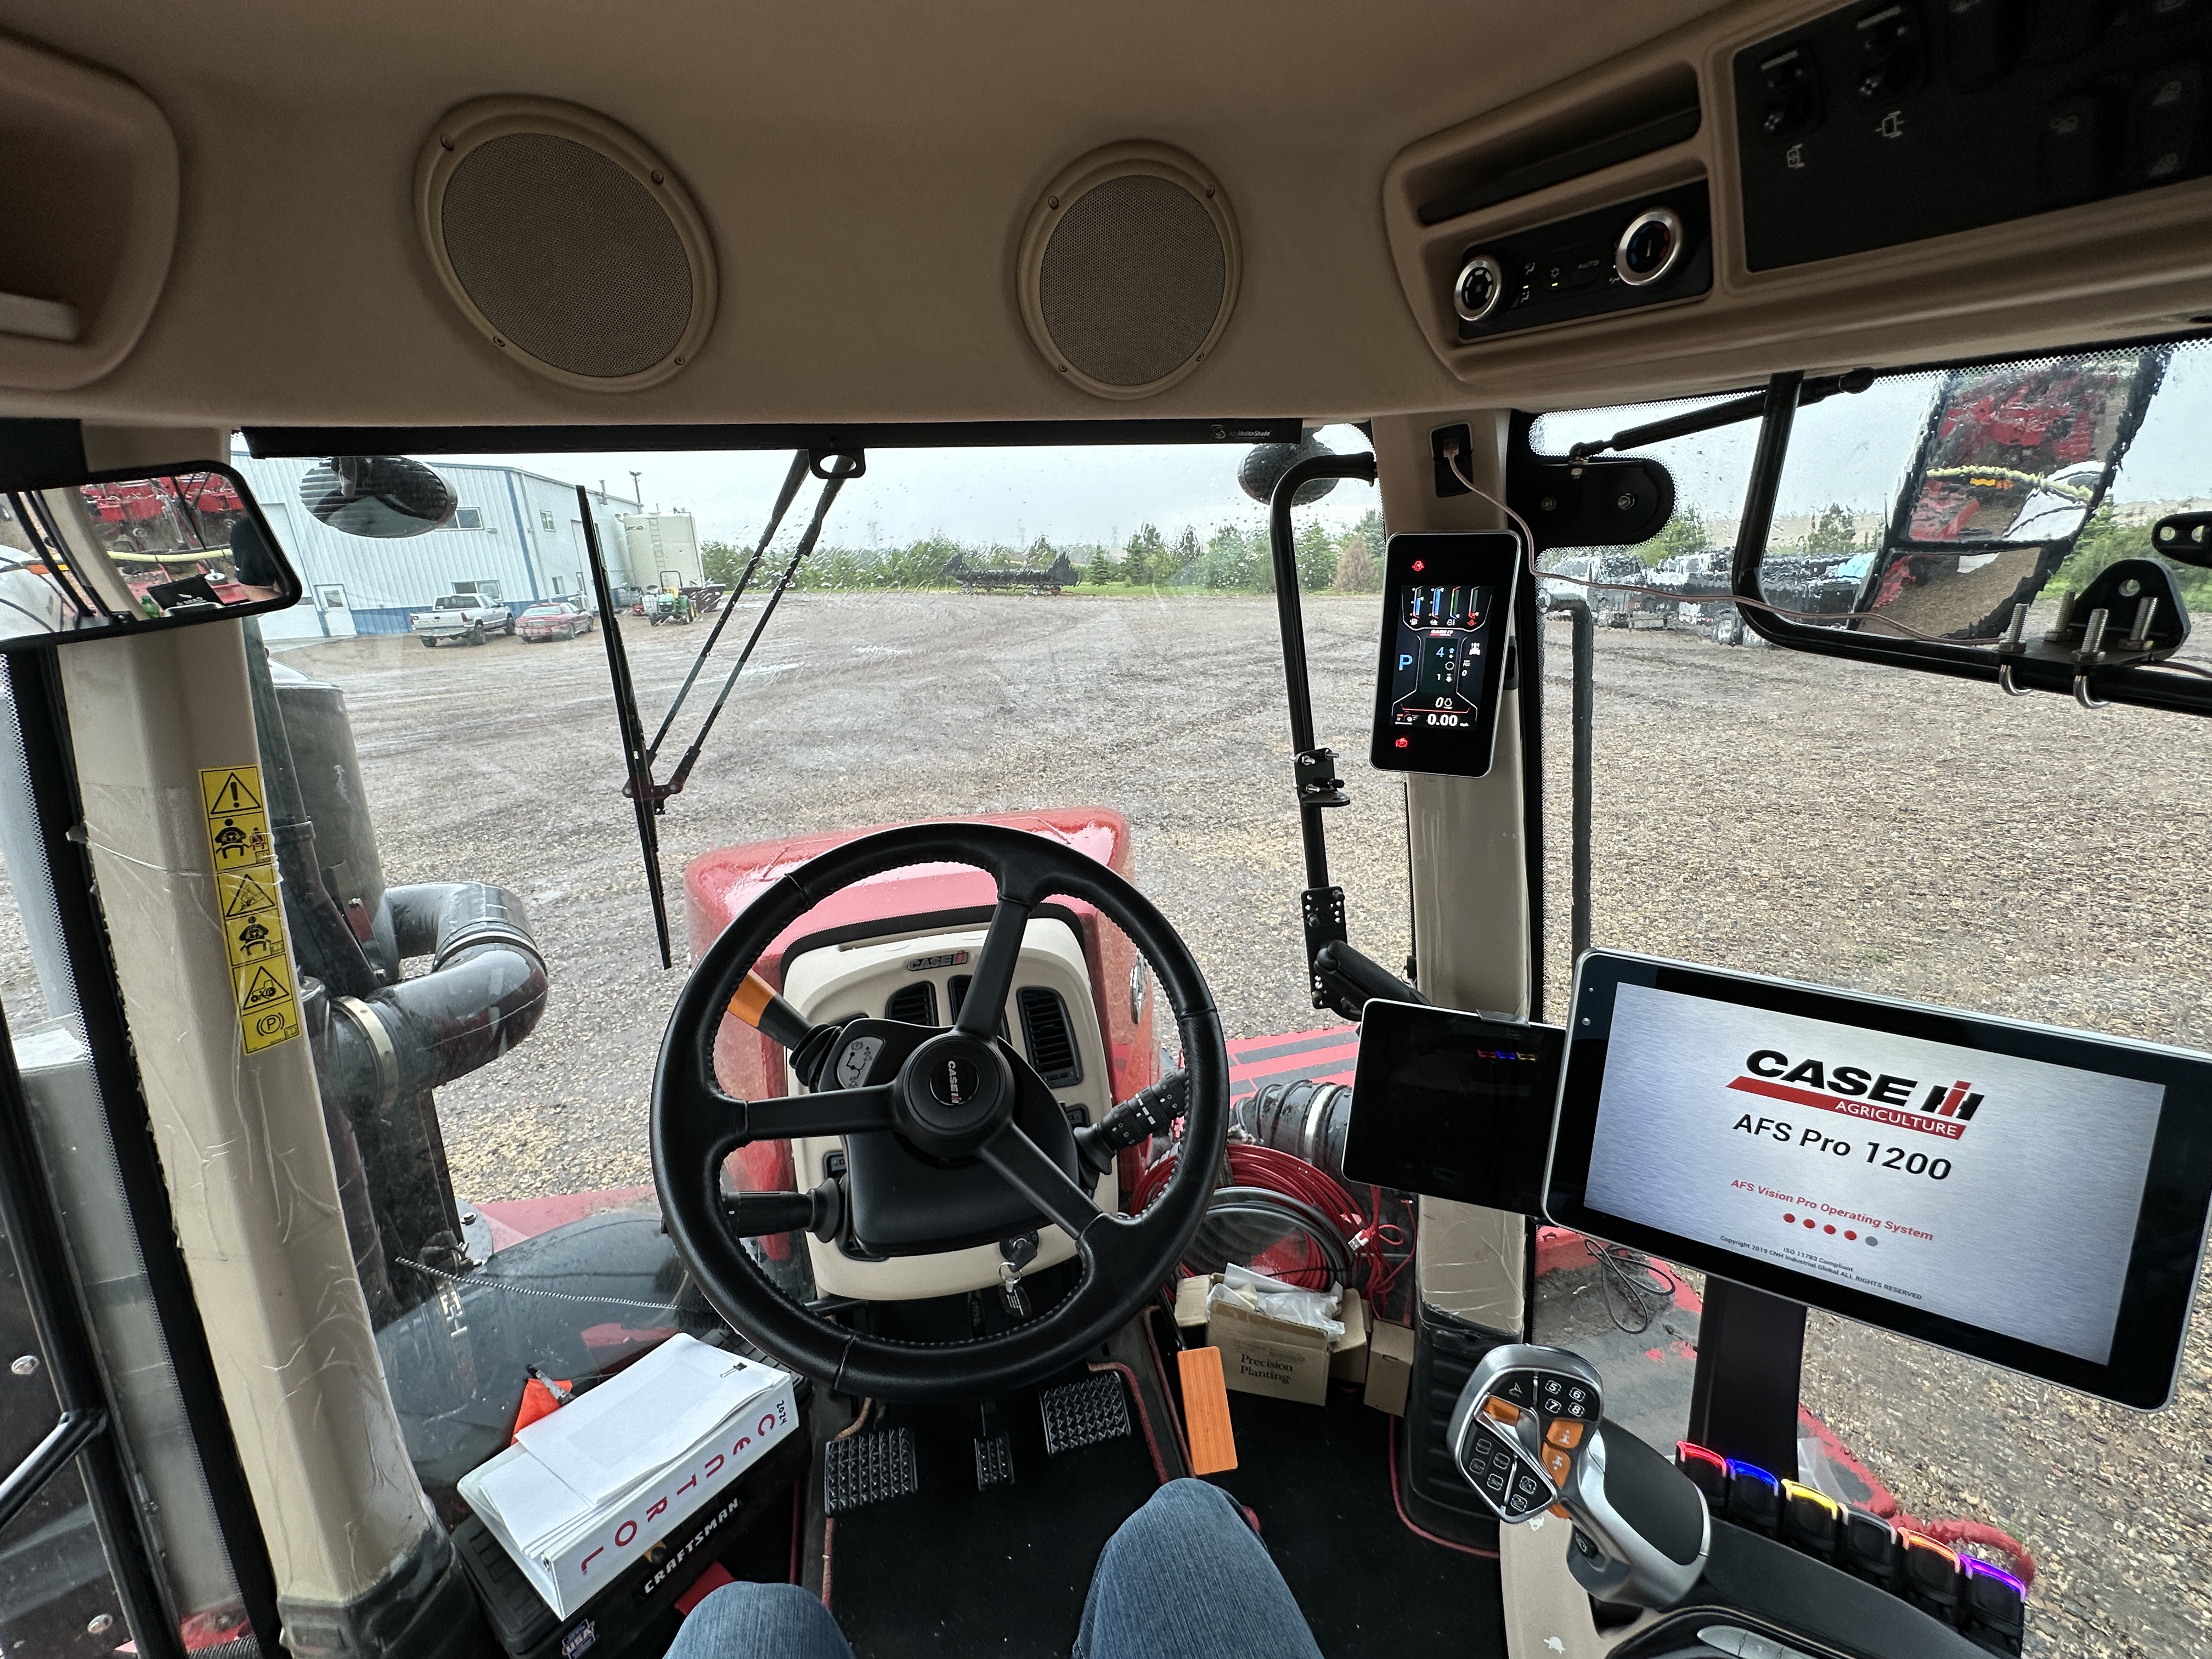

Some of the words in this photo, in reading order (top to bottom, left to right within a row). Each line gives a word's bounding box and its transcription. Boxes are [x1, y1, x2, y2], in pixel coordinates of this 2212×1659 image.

[1578, 259, 1599, 269] AUTO
[1398, 654, 1413, 671] P
[1436, 647, 1444, 658] 4
[1435, 697, 1444, 708] 0
[1427, 713, 1458, 727] 0.00
[908, 955, 952, 971] CASE
[948, 1060, 958, 1092] CASE
[1746, 1049, 1918, 1107] CASE
[1835, 1101, 1957, 1137] AGRICULTURE
[1732, 1114, 1792, 1142] AFS
[1799, 1128, 1851, 1156] Pro
[1866, 1141, 1951, 1180] 1200
[1731, 1180, 1754, 1192] AFS
[1758, 1186, 1793, 1203] Vision
[1796, 1197, 1817, 1209] Pro
[1820, 1203, 1881, 1228] Operating
[1884, 1220, 1934, 1241] System
[1720, 1235, 1750, 1249] Copyright
[1751, 1244, 1768, 1254] 2019
[1769, 1250, 1784, 1259] CNH
[1785, 1255, 1816, 1268] Industrial
[1817, 1264, 1839, 1276] Global
[1840, 1271, 1854, 1280] ALL
[1855, 1276, 1882, 1288] RIGHTS
[1883, 1284, 1922, 1300] RESERVED
[1783, 1247, 1796, 1255] ISO
[1819, 1257, 1854, 1272] Compliant
[1240, 1353, 1293, 1372] Precision
[1240, 1364, 1289, 1384] Planting
[776, 1400, 787, 1426] 2024
[645, 1498, 738, 1594] CRAFTSMAN
